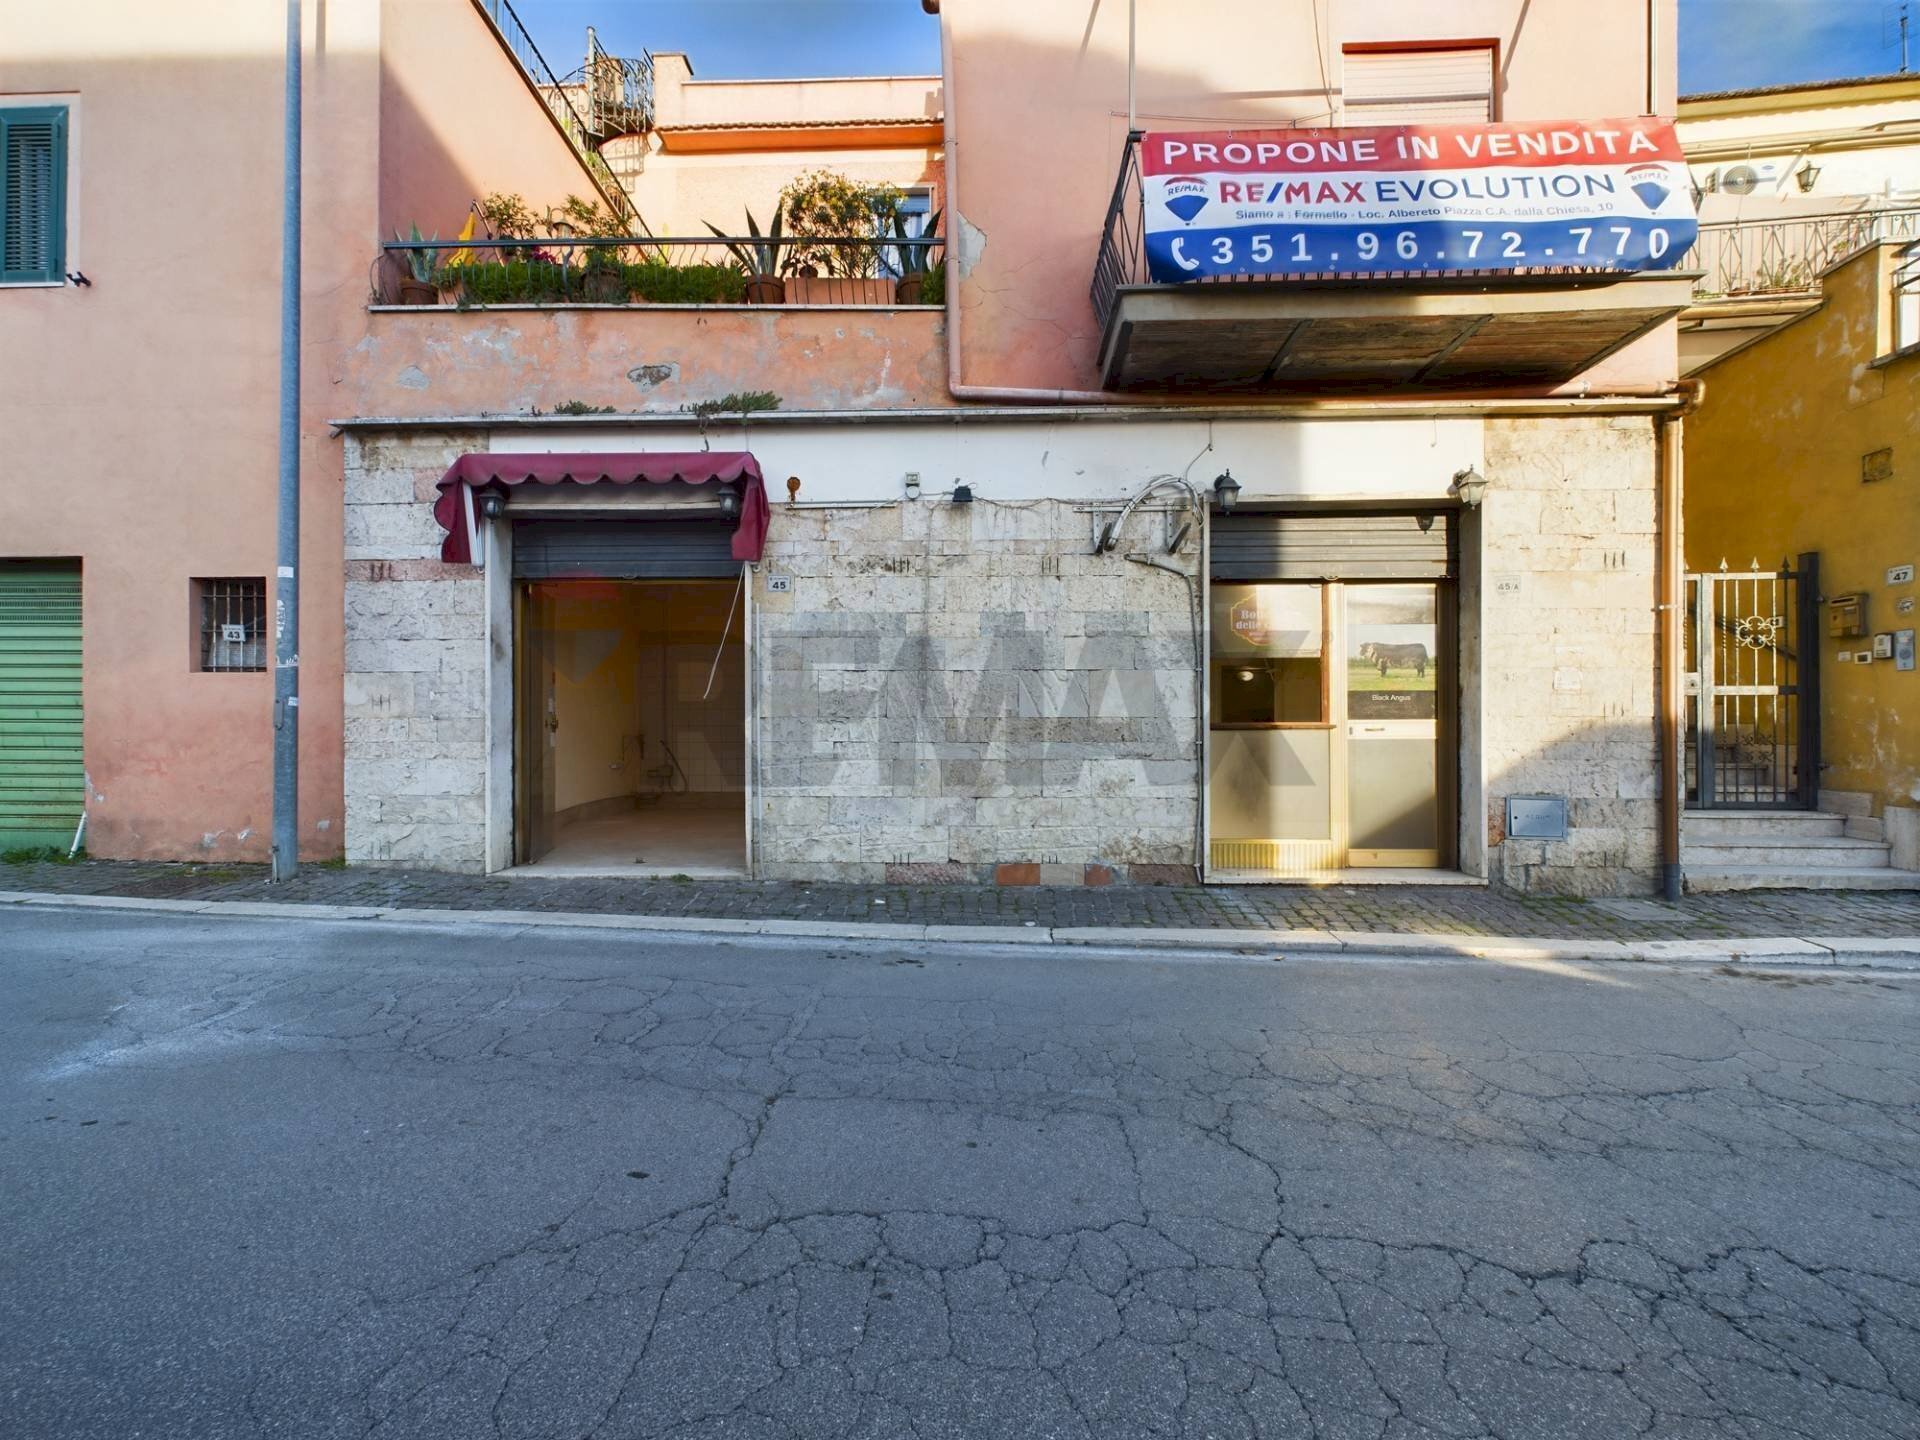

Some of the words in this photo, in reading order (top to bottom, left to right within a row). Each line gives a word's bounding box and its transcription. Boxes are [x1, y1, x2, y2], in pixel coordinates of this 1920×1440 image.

[1163, 139, 1379, 165] PROPONE
[1397, 134, 1439, 160] IN
[1455, 130, 1660, 157] VENDITA
[1167, 184, 1206, 195] RE/MAX
[1218, 181, 1367, 205] RE/MAX
[1375, 173, 1616, 203] EVOLUTION
[1235, 209, 1274, 219] Siamo
[1294, 209, 1348, 219] Formello
[1358, 209, 1385, 219] Loc.
[1388, 203, 1441, 218] Albereto
[1444, 206, 1482, 216] Piazza
[1514, 207, 1544, 216] dalla
[1546, 204, 1595, 215] Chiesa,
[1597, 202, 1614, 211] 10
[1893, 571, 1908, 580] 47
[772, 581, 787, 590] 45
[227, 631, 240, 639] 43
[1391, 694, 1412, 703] Angus
